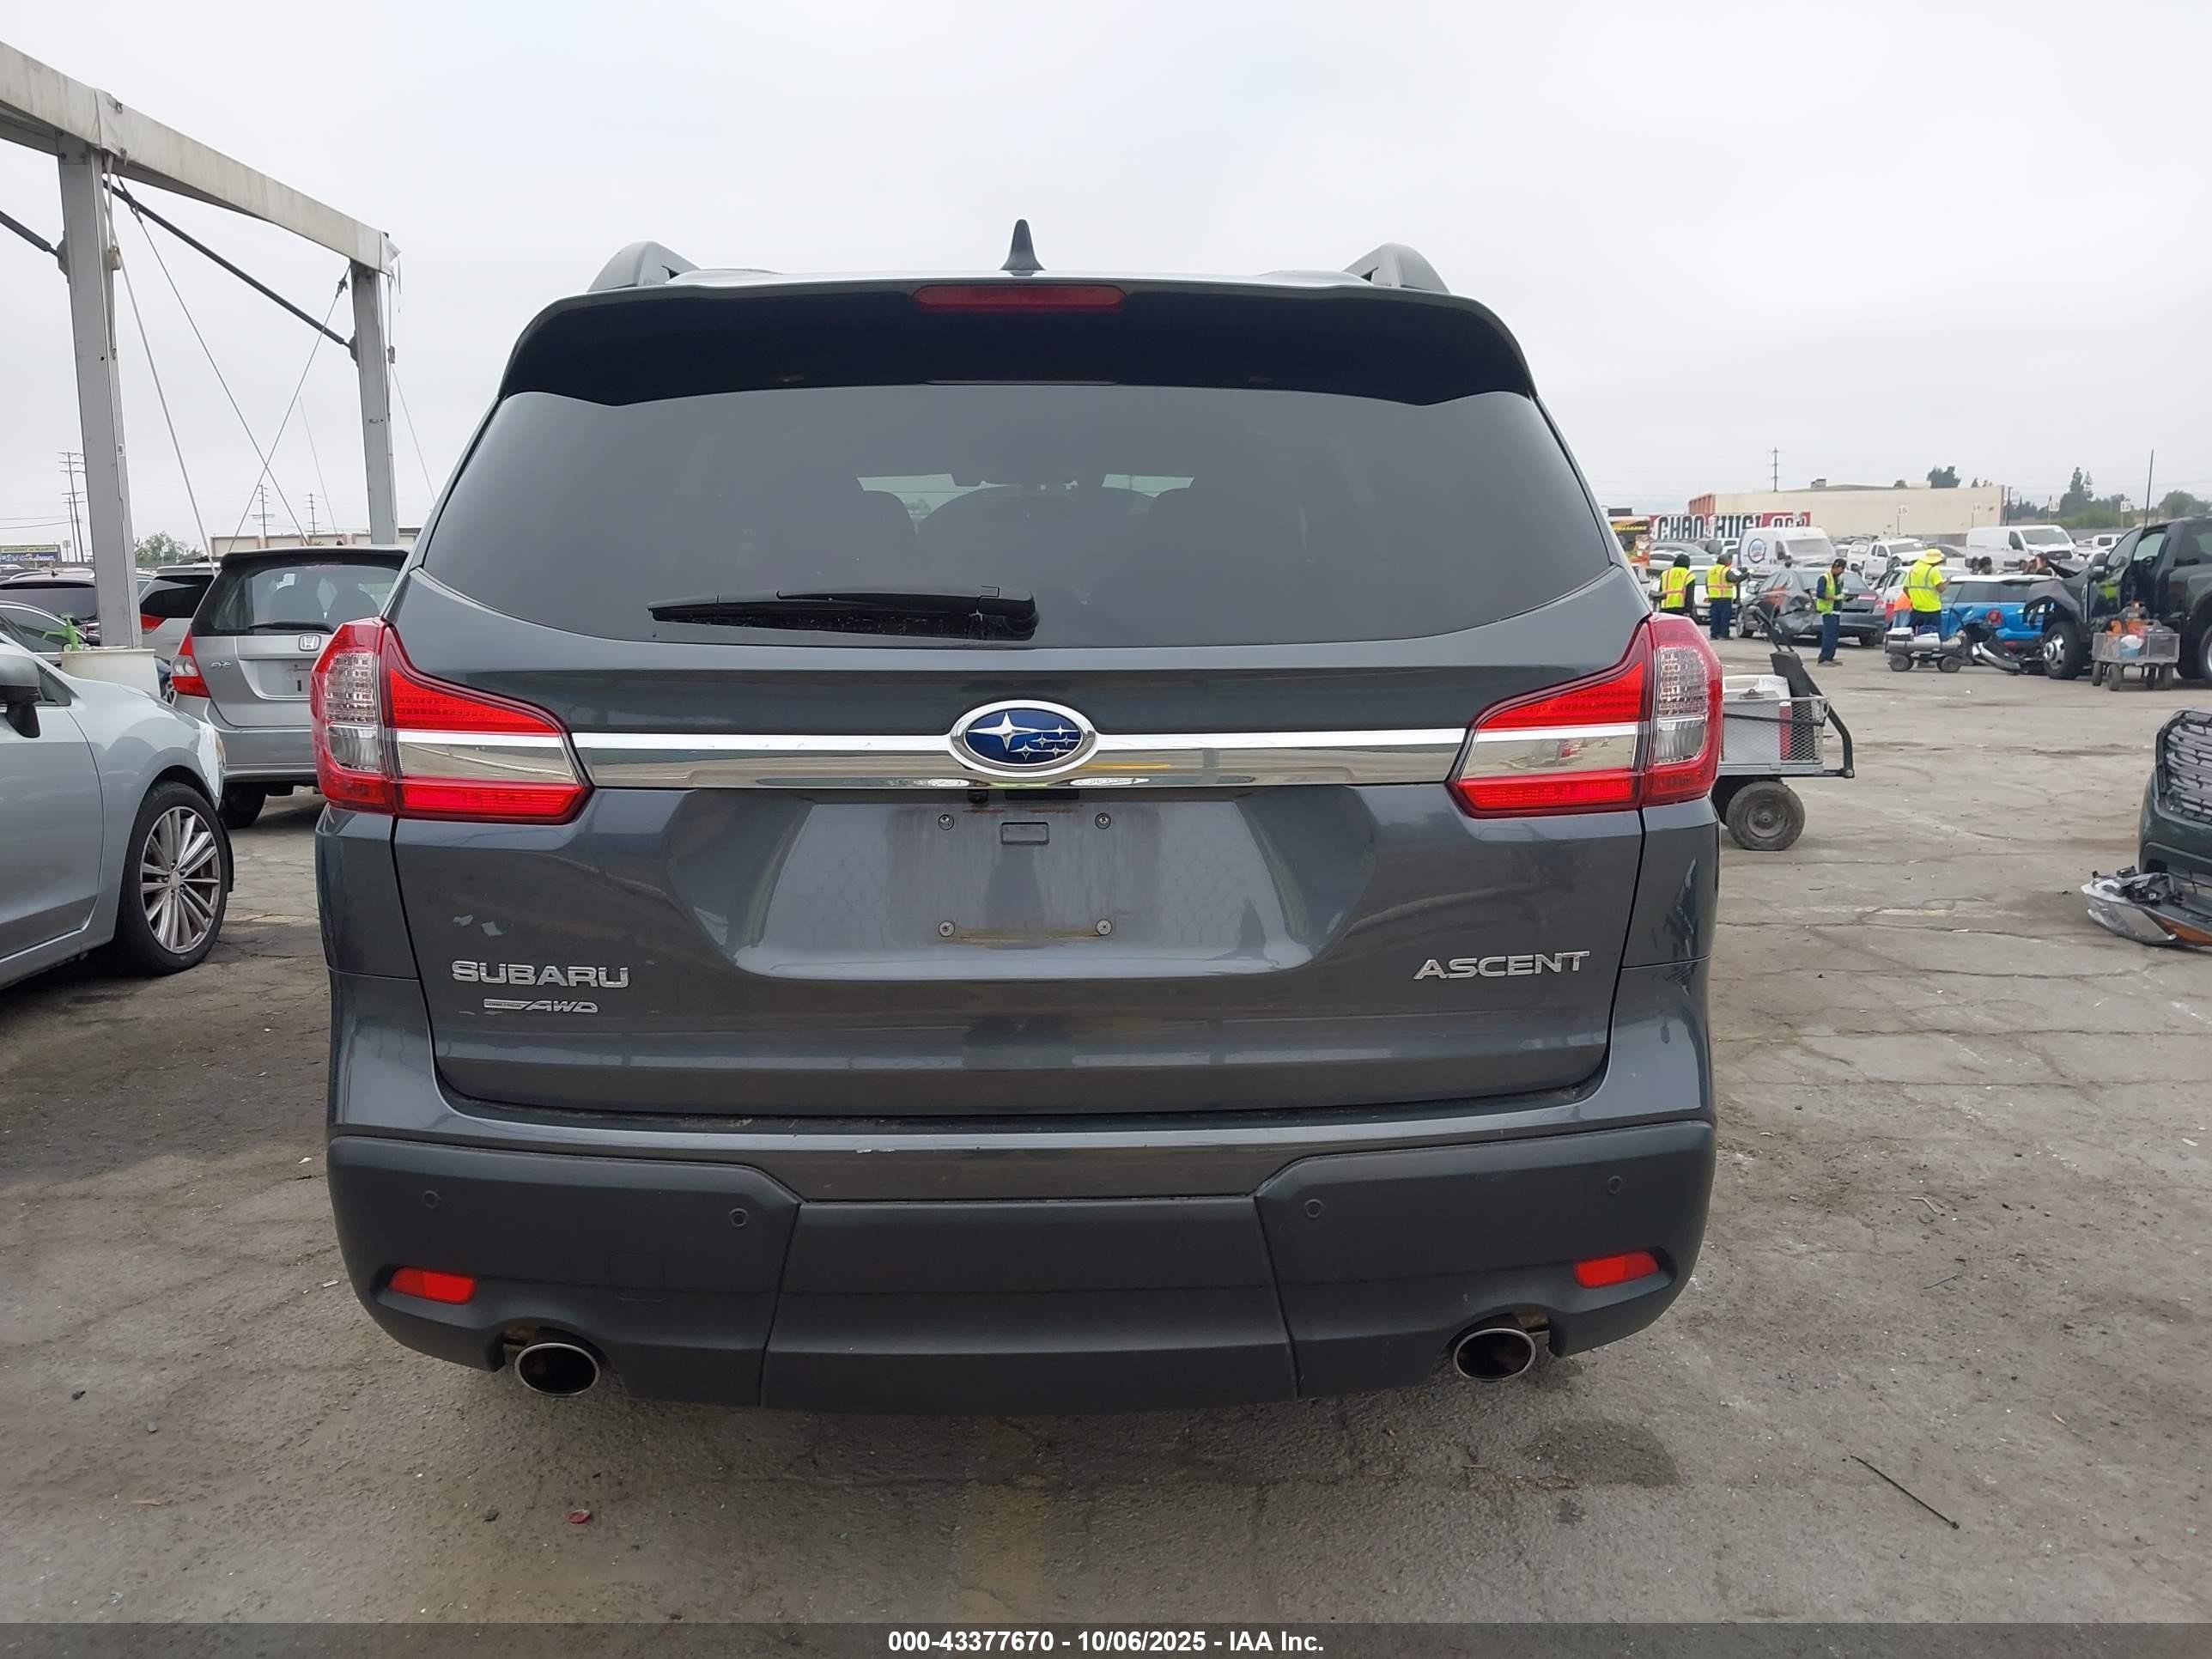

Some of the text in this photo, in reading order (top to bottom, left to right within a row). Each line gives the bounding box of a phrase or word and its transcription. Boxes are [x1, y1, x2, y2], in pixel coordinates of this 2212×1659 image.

[452, 960, 629, 988] SUBARU
[1413, 951, 1591, 981] ASCENT
[525, 1000, 599, 1013] AWD
